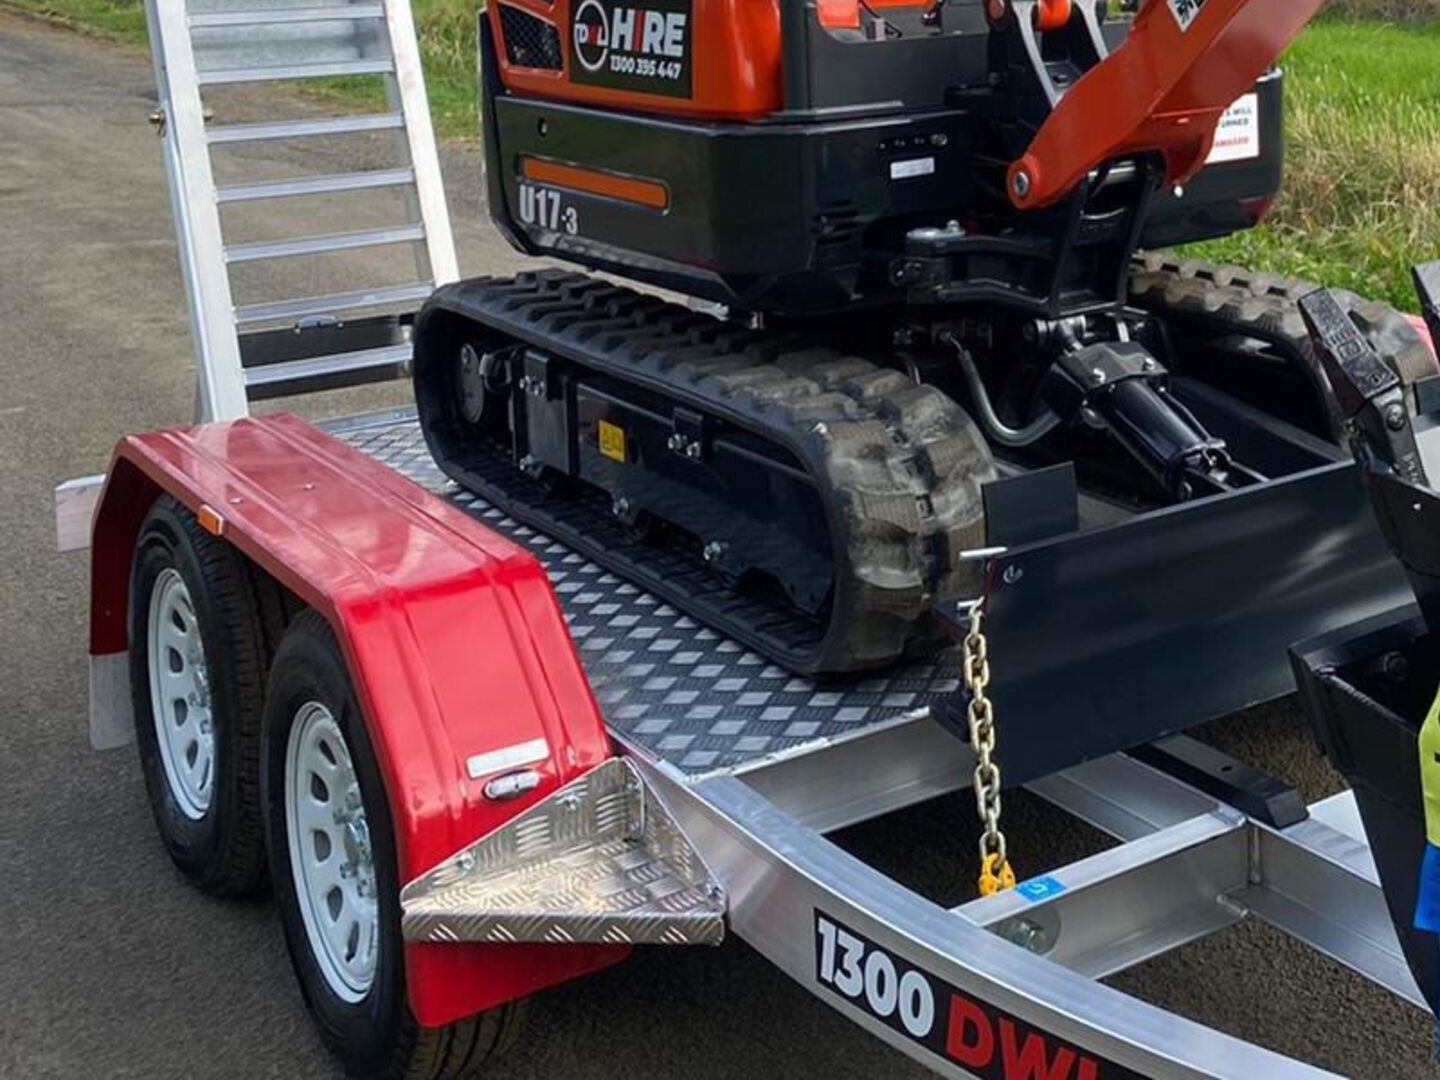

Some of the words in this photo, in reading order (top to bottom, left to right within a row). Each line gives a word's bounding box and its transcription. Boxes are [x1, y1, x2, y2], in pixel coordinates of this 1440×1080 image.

[611, 7, 687, 57] HIRE
[610, 55, 636, 74] 1300
[816, 917, 935, 1039] 1300
